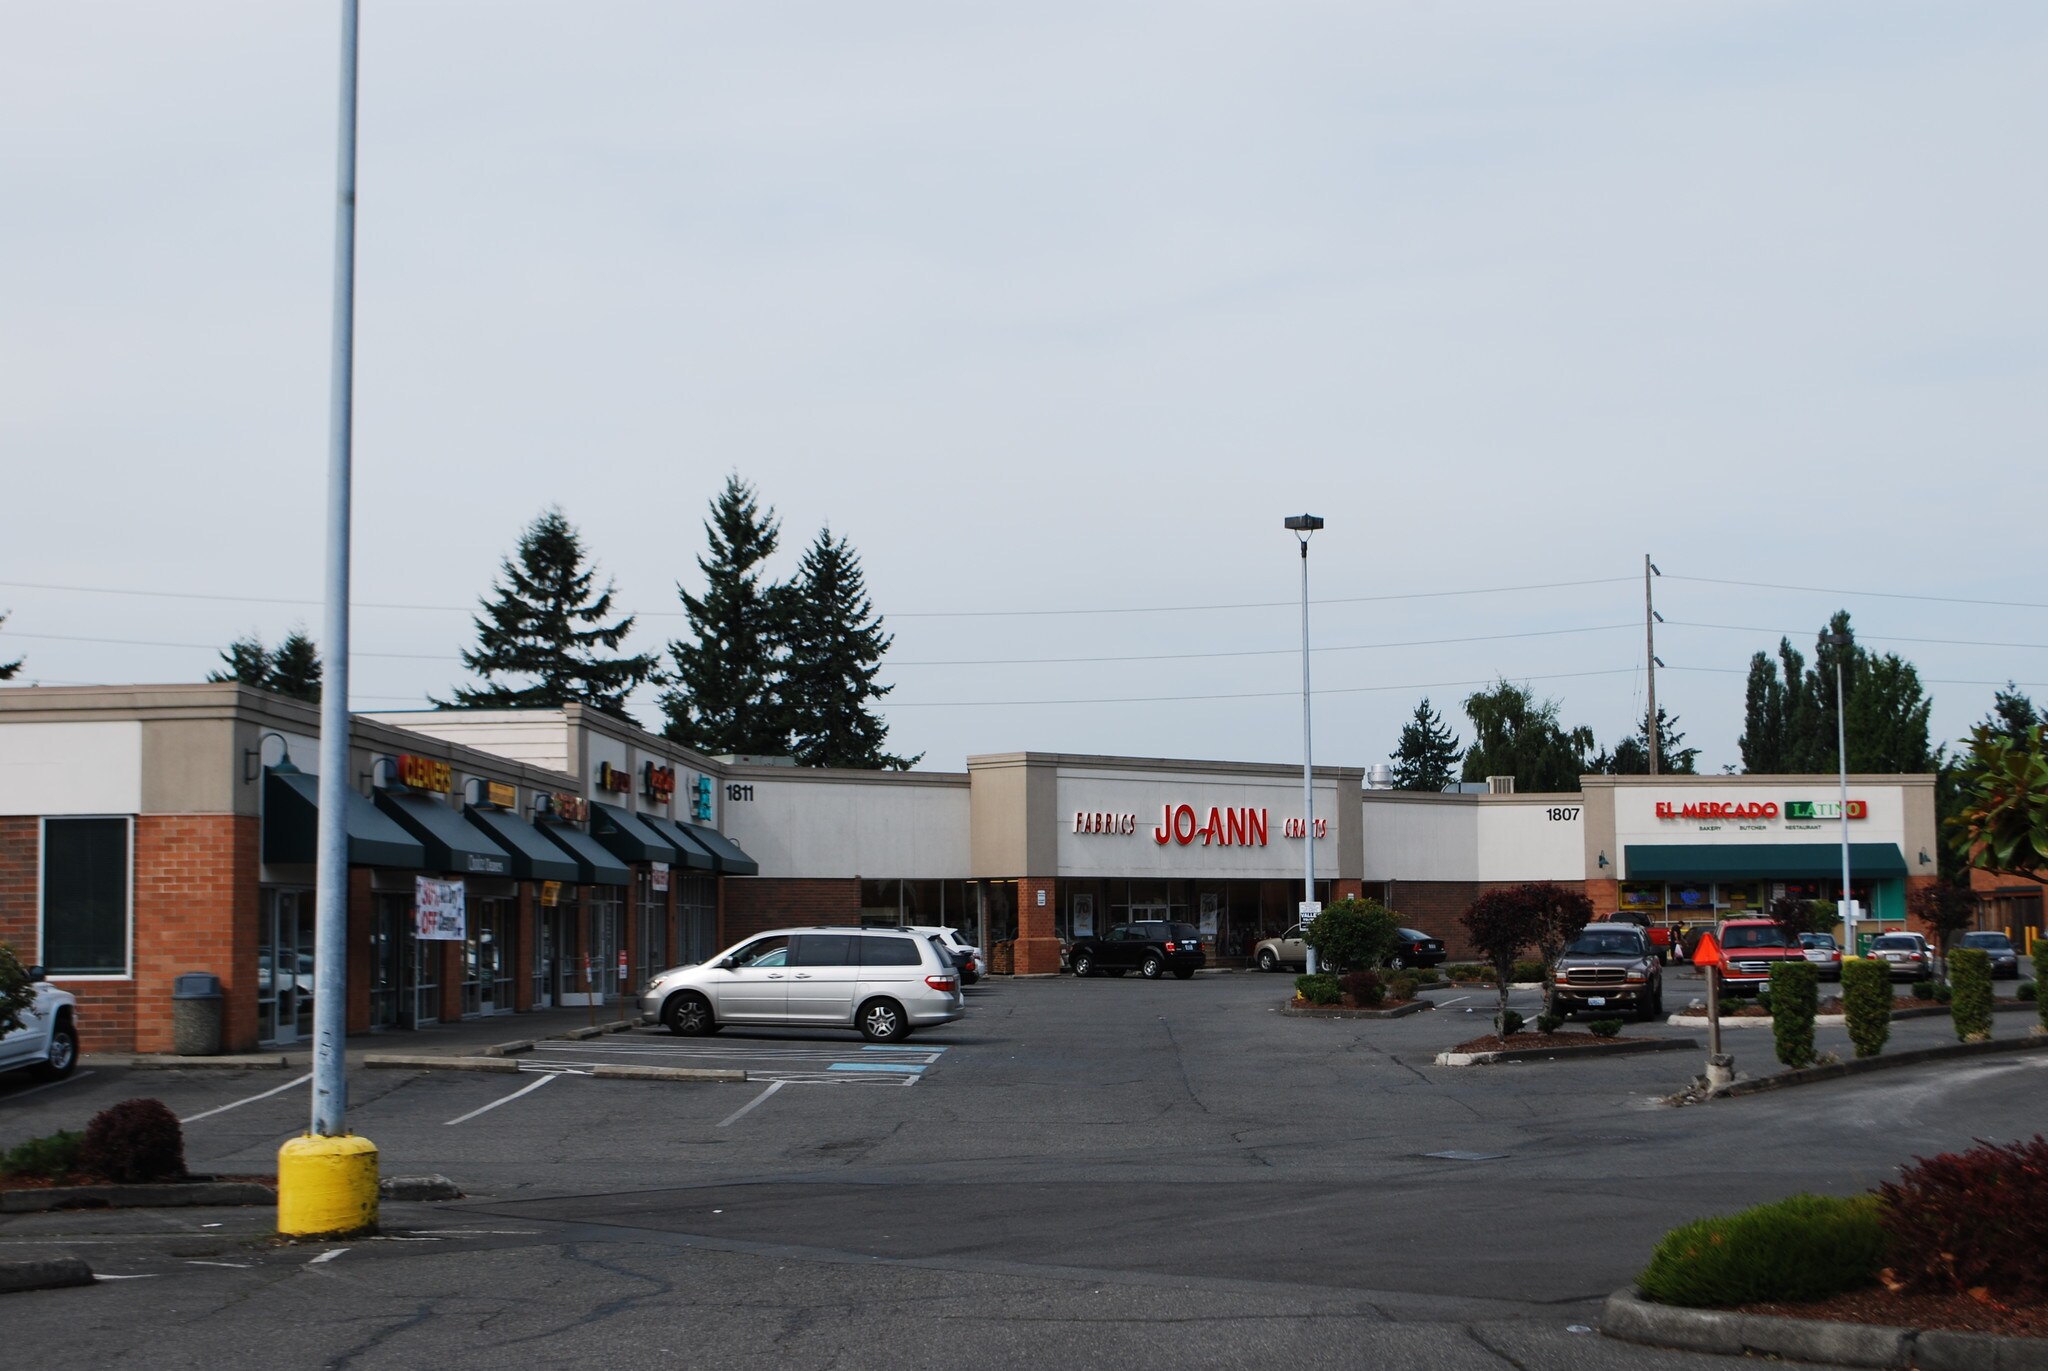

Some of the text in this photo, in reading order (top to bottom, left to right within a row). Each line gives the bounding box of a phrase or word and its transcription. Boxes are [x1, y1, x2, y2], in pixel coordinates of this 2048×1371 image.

[726, 784, 754, 801] 1811
[1546, 808, 1580, 821] 1807
[1656, 802, 1778, 818] EL MERCADO
[1074, 812, 1136, 834] FABRICS
[1284, 818, 1327, 839] CRATS
